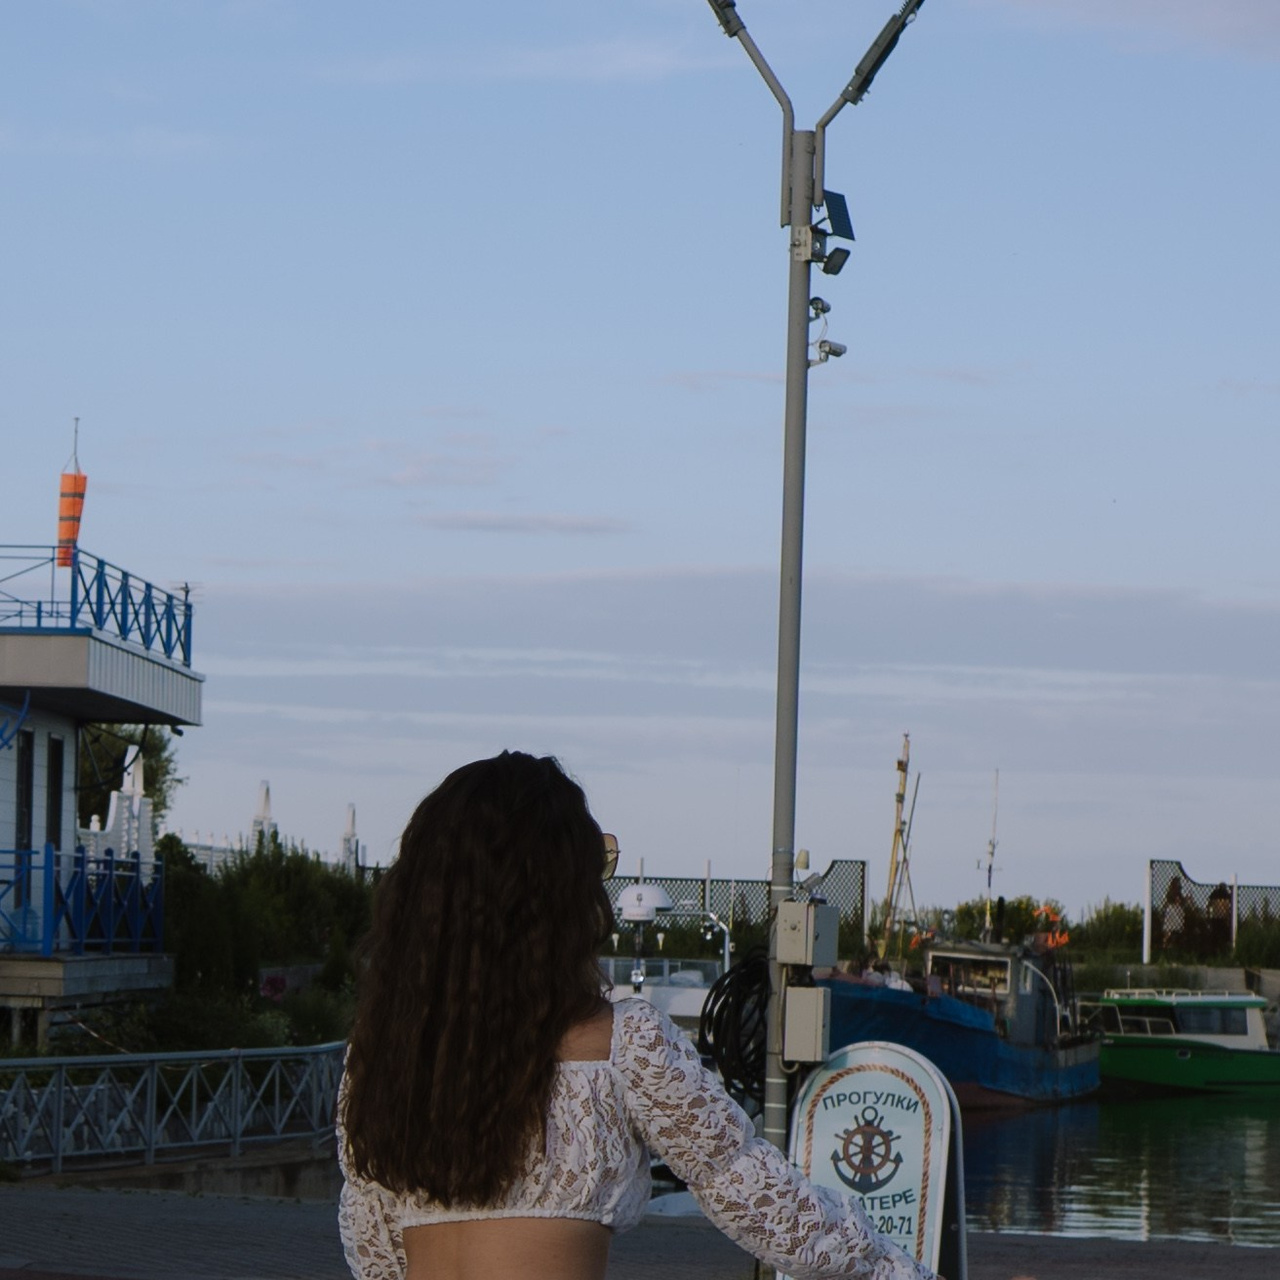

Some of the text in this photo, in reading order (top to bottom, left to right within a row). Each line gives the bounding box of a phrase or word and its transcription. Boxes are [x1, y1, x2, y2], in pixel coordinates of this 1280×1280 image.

[822, 1091, 920, 1114] ПРОГУЛКИ
[857, 1188, 916, 1211] АТЕРЕ
[868, 1215, 913, 1235] -20-71
